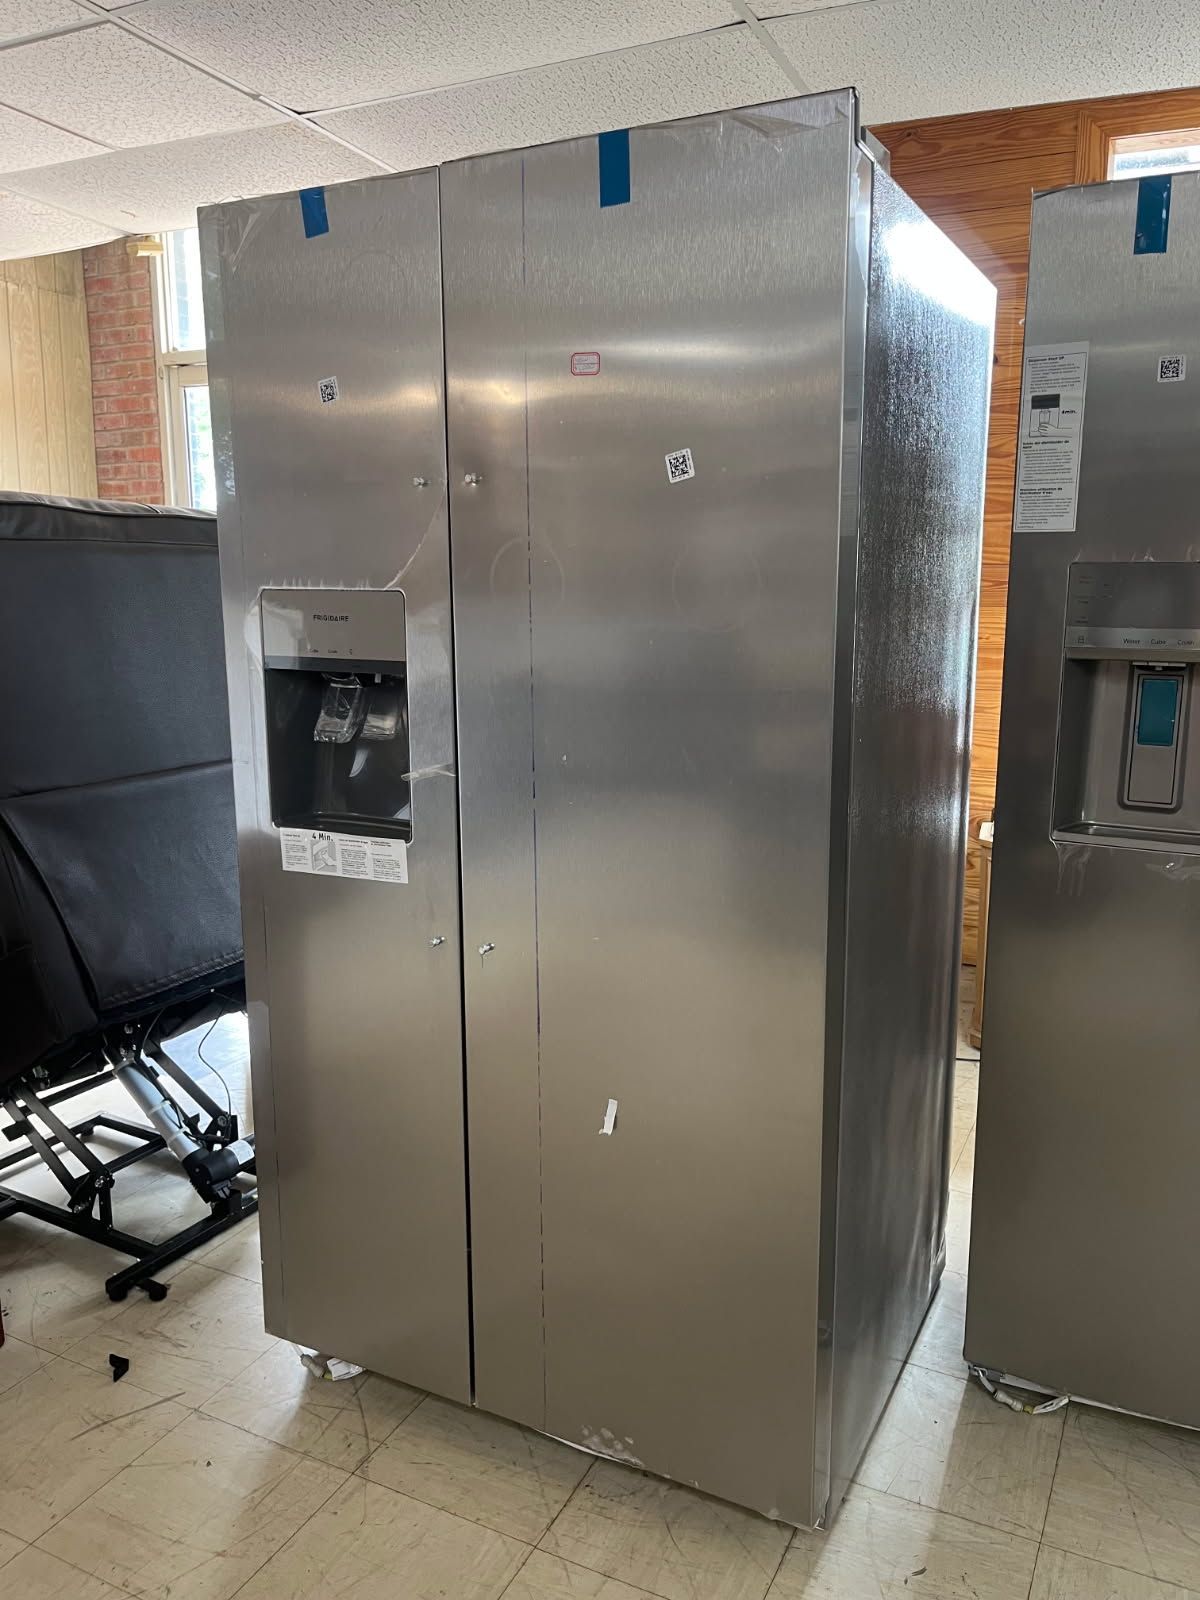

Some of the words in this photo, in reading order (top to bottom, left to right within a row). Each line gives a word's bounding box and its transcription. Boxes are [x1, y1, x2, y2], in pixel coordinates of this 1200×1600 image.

[313, 614, 349, 622] FRIGIDAIRE
[312, 832, 317, 840] 4
[318, 832, 334, 842] Min.
